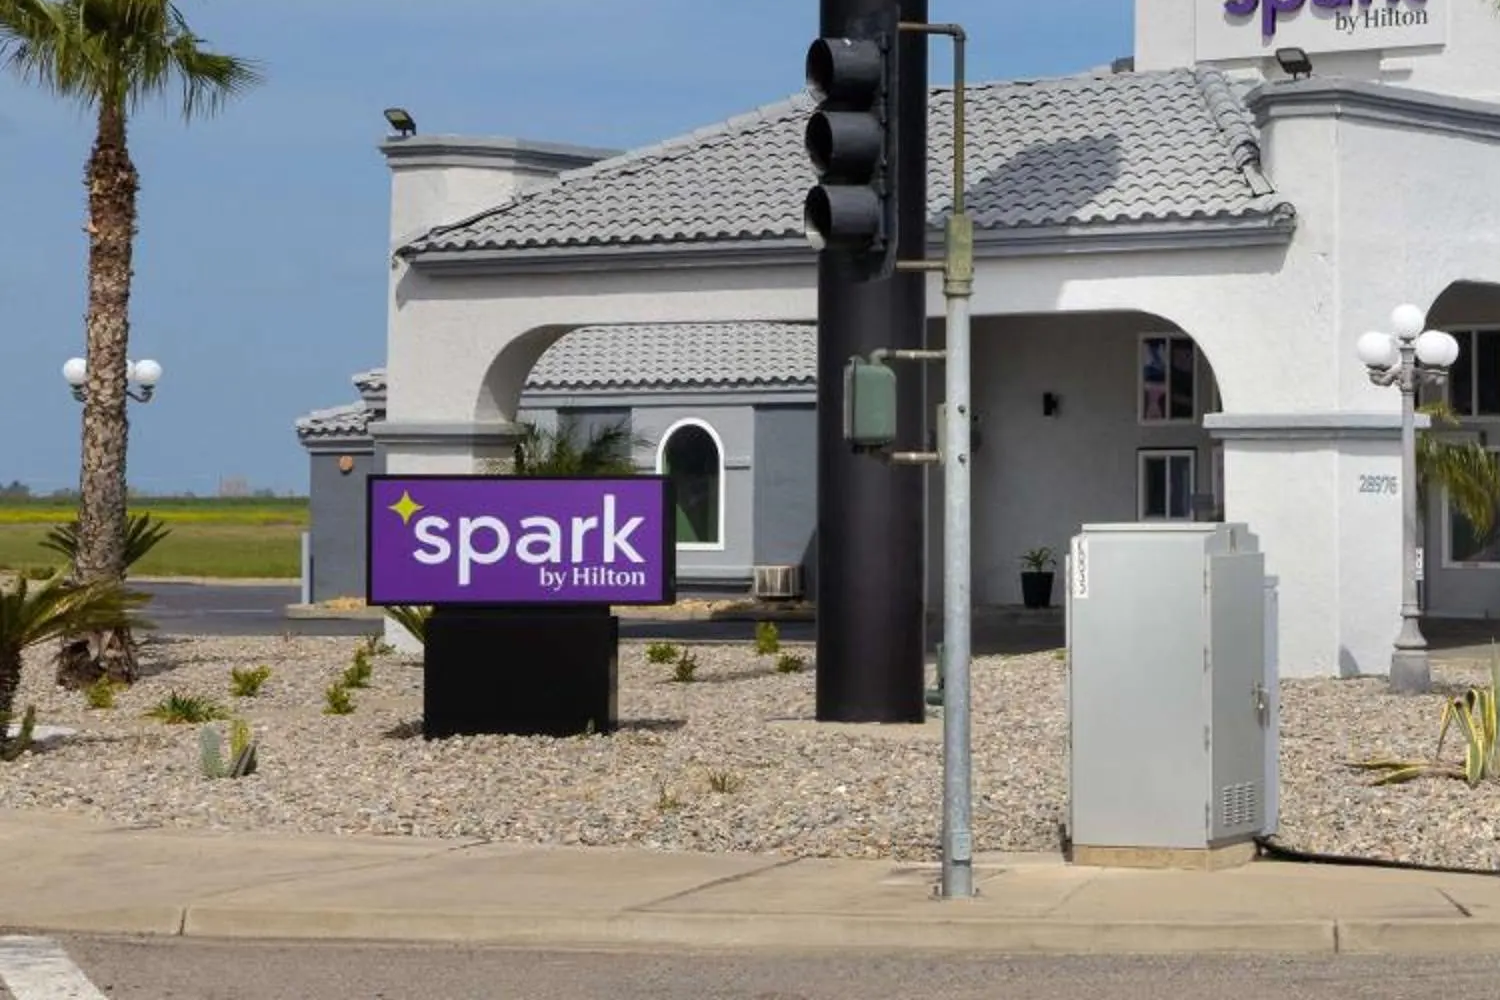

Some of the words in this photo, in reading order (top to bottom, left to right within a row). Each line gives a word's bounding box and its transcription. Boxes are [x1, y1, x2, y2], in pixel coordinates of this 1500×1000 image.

[1335, 10, 1358, 35] by
[1364, 7, 1428, 28] Hilton
[413, 494, 645, 585] spark
[540, 567, 567, 591] by
[573, 567, 645, 586] Hilton
